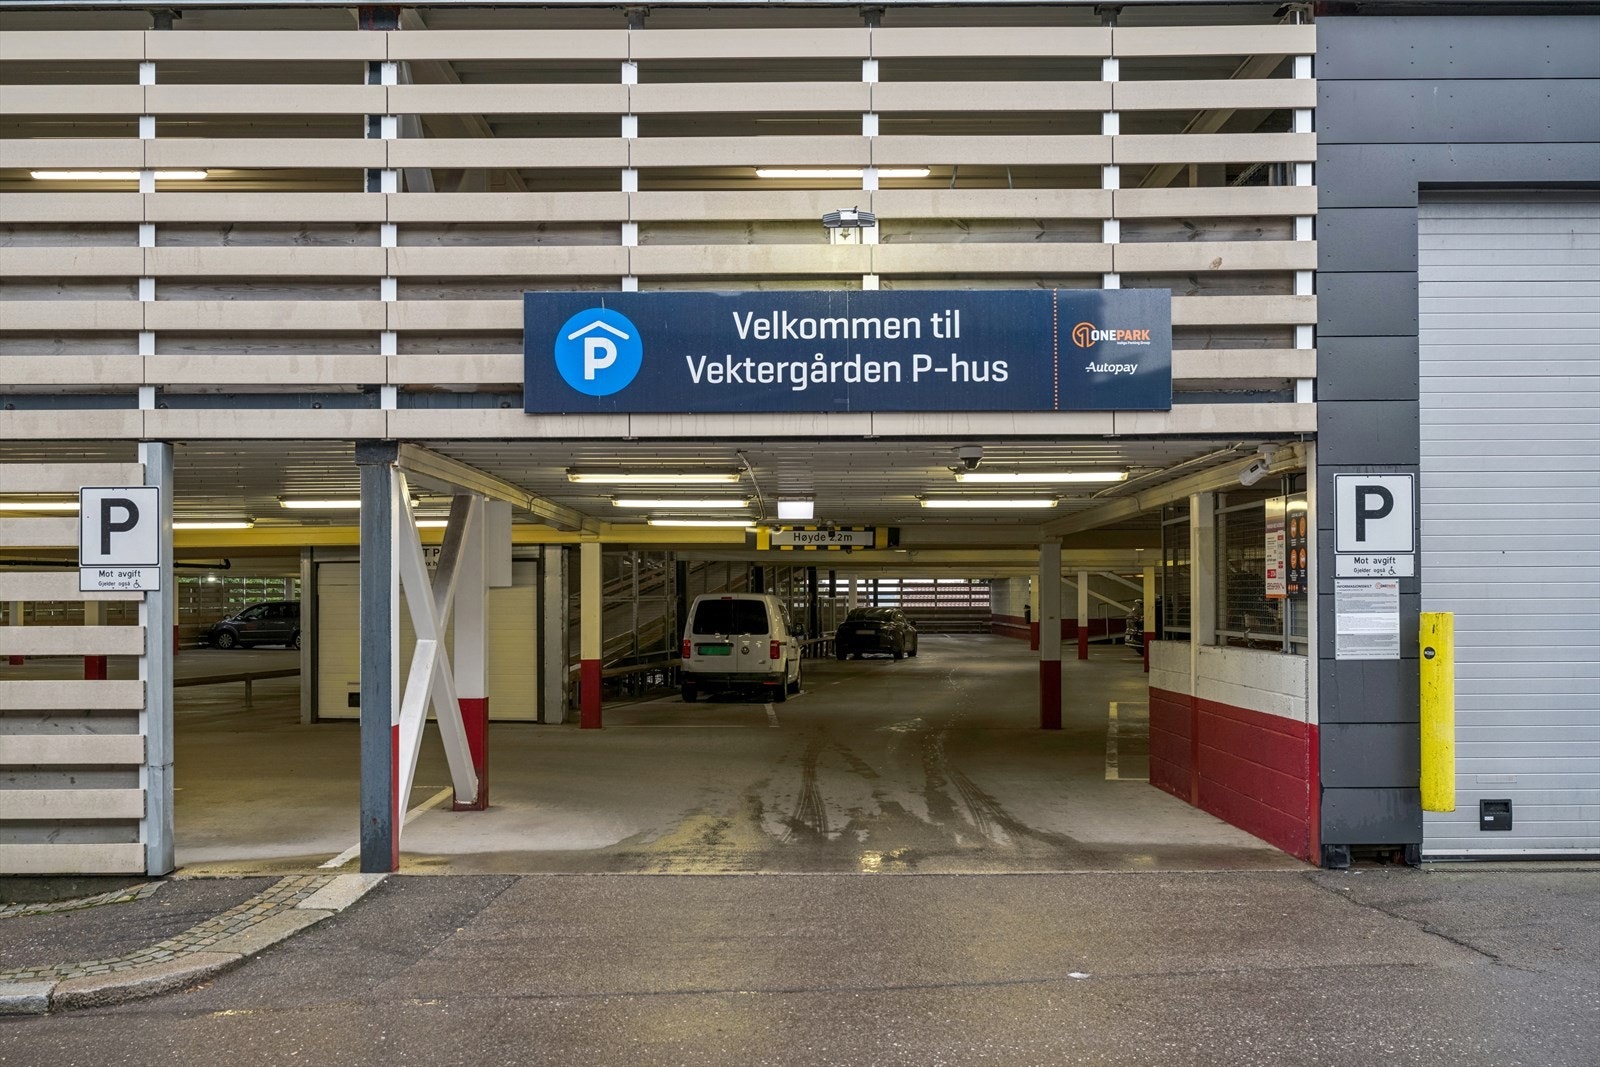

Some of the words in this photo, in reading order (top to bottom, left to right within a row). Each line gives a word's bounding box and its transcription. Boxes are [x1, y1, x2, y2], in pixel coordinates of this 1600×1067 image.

[732, 310, 922, 341] Velkommen
[930, 309, 962, 341] til
[1091, 329, 1151, 341] ONEPARK
[584, 337, 618, 380] P
[685, 352, 902, 391] Vektergården
[911, 353, 1009, 383] P-hus
[1085, 361, 1138, 375] Autopay
[1355, 485, 1394, 542] P
[100, 498, 140, 555] P
[793, 532, 826, 543] Høyde
[1353, 556, 1369, 564] Mot
[1372, 556, 1396, 566] avgift
[98, 570, 114, 578] Mot
[117, 569, 142, 580] avgift
[97, 580, 116, 588] Gjelder
[118, 580, 131, 588] også
